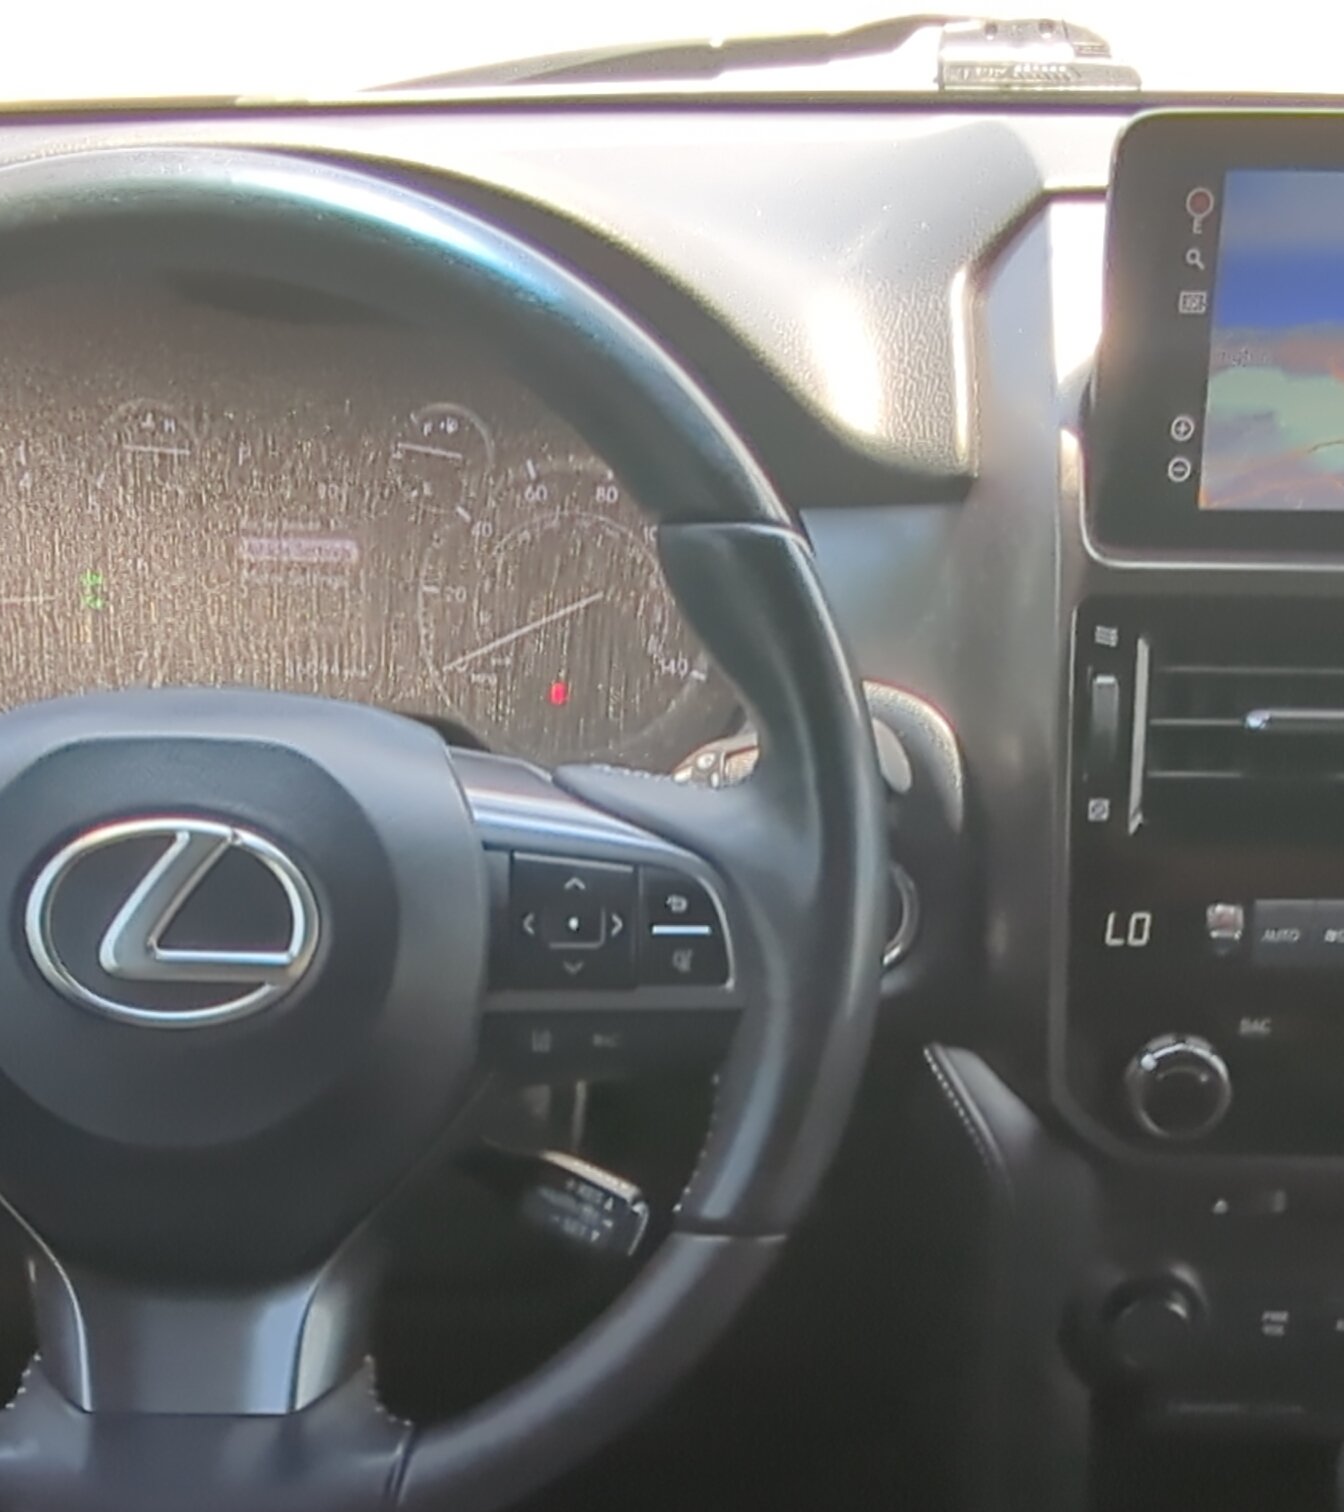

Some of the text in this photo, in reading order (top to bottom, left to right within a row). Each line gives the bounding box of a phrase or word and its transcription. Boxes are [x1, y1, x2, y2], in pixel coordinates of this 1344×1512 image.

[524, 484, 548, 502] 60
[596, 485, 619, 503] 80
[1104, 911, 1152, 947] LO
[1261, 928, 1301, 943] AUTO
